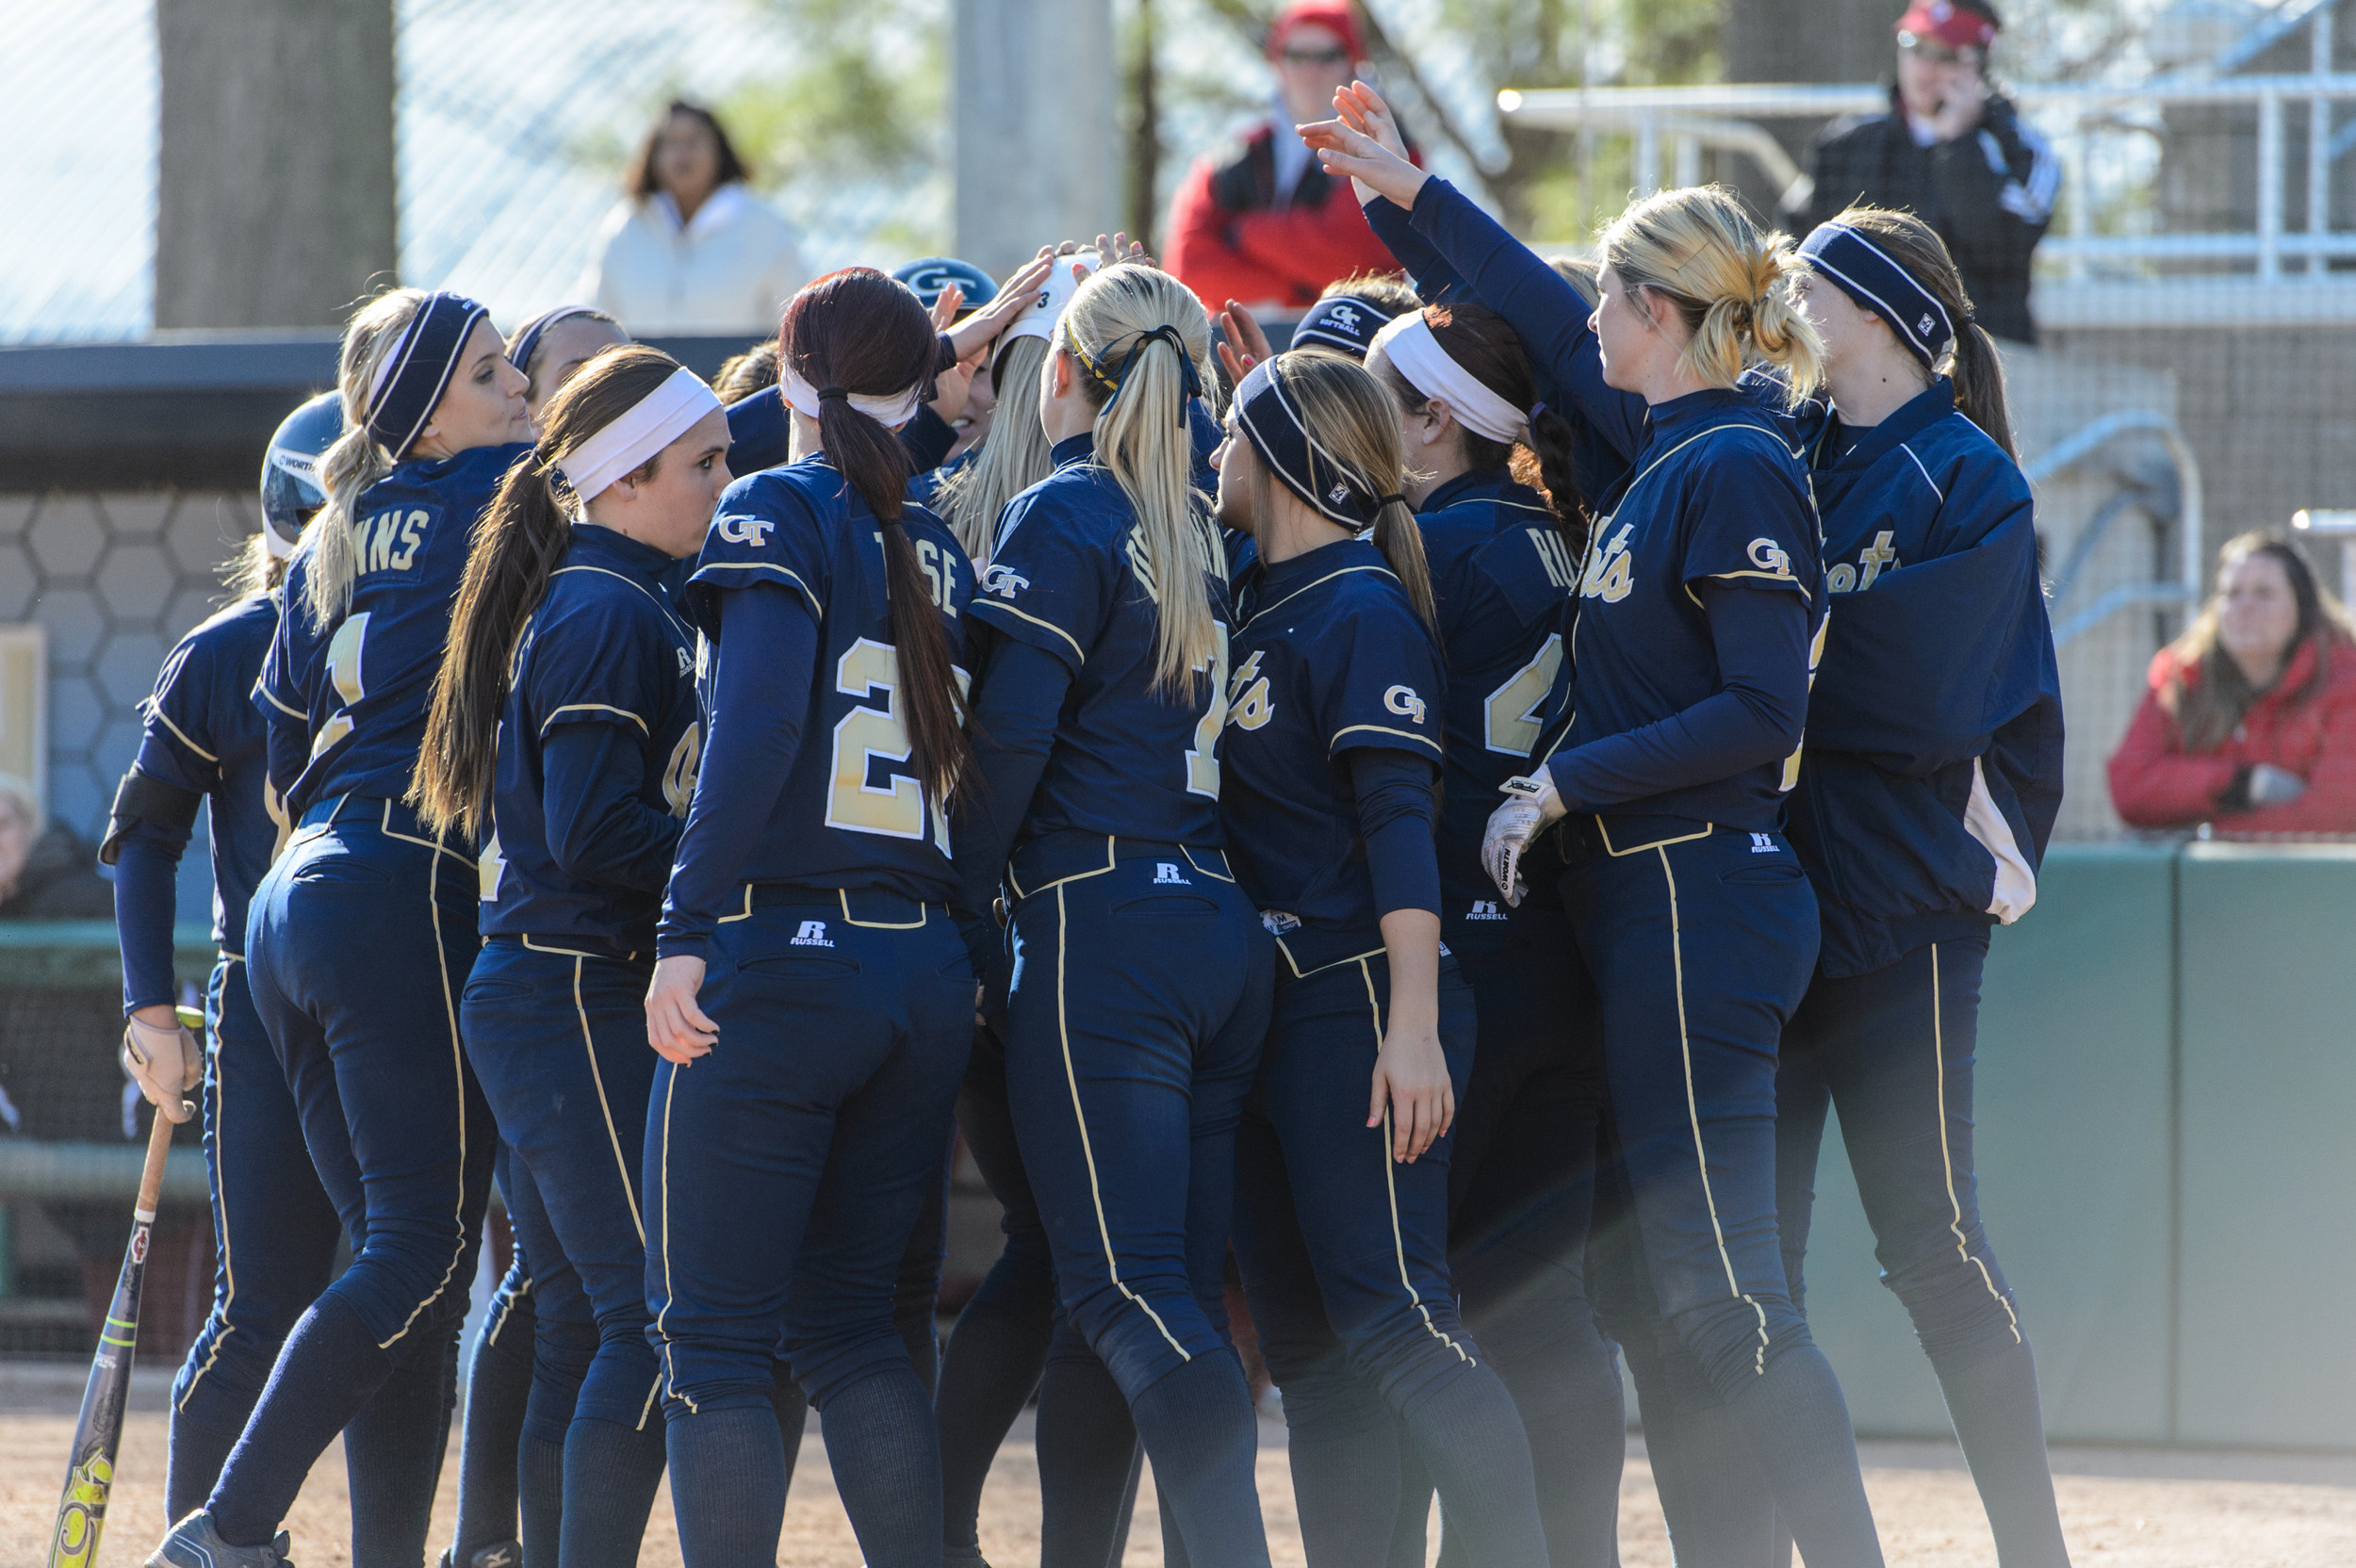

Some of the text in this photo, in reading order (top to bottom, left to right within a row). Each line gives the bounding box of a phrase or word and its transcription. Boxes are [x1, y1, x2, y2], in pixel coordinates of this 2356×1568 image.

[1038, 291, 1050, 309] 3
[1319, 318, 1360, 336] SOFTBALL
[1331, 305, 1361, 327] GT
[719, 514, 775, 547] GT
[1526, 528, 1580, 588] RU
[1746, 537, 1791, 576] GT
[982, 564, 1030, 599] GT
[1383, 685, 1426, 725] GT
[1751, 844, 1780, 854] RUSSELL
[1502, 848, 1511, 882] WORTH
[1465, 912, 1508, 921] RUSSELL
[790, 937, 835, 948] RUSSELL
